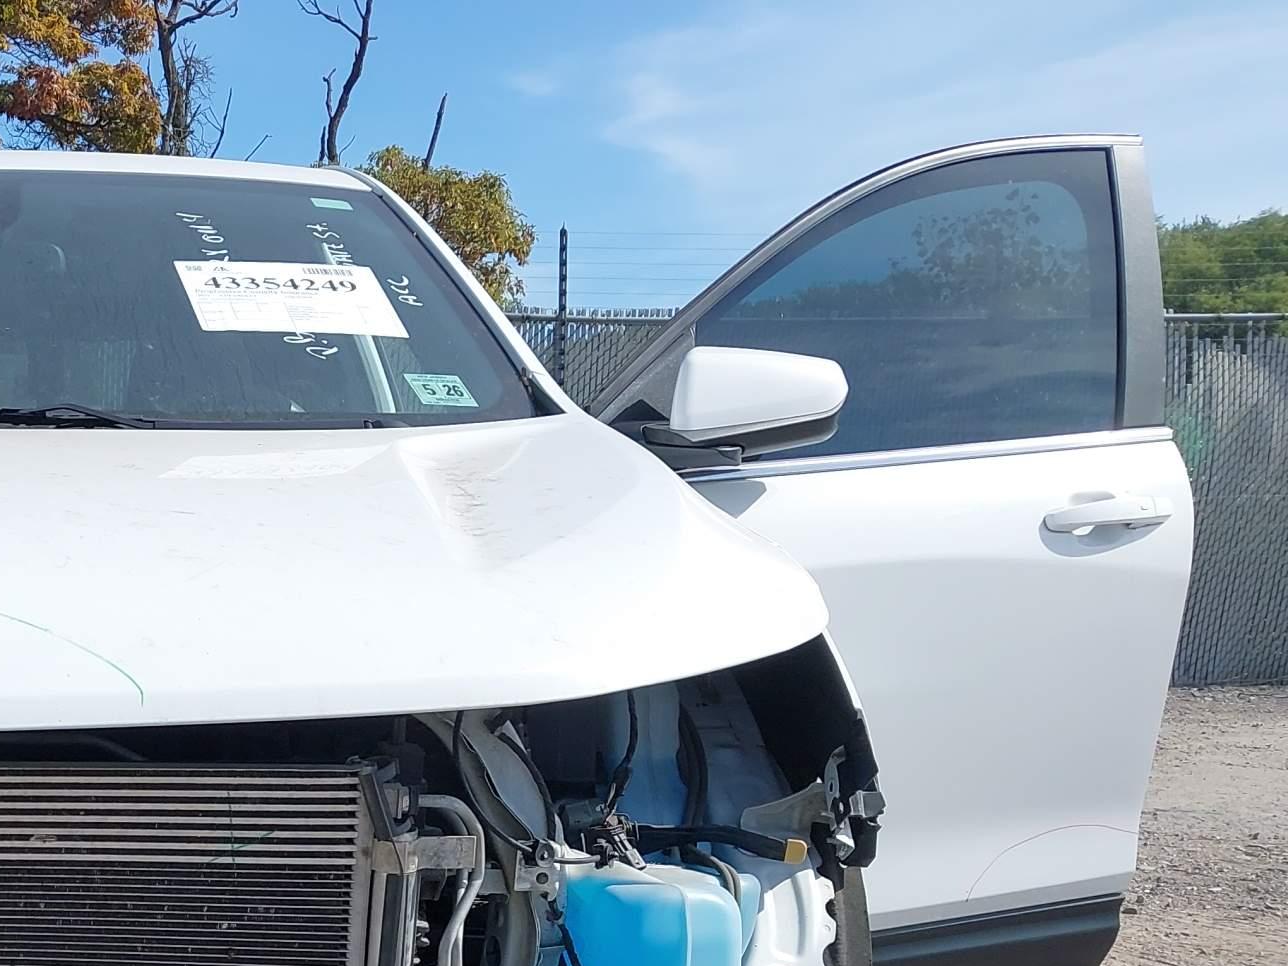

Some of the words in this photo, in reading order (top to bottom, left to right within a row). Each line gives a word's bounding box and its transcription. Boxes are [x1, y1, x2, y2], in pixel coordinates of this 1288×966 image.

[204, 276, 358, 294] 43354249
[421, 383, 437, 396] 5
[442, 384, 465, 397] 26
